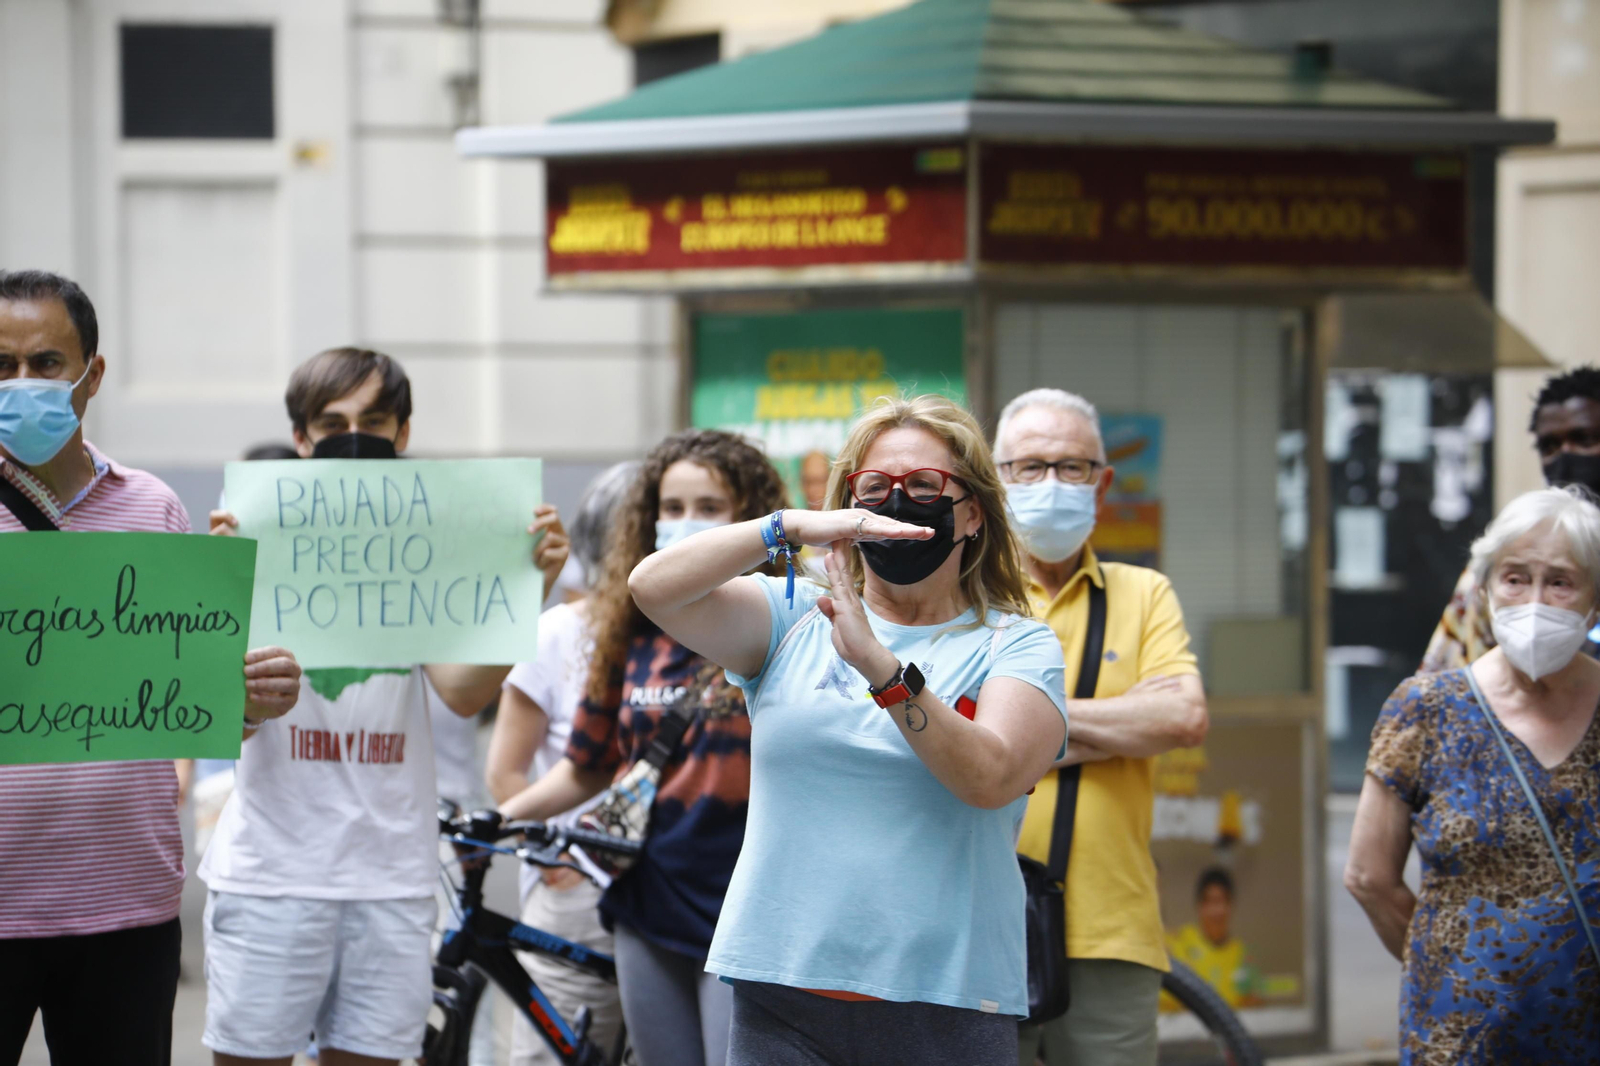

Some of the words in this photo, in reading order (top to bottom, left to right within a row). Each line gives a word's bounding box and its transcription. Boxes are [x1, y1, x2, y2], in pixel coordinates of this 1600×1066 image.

[276, 472, 432, 529] BAJADA
[292, 533, 433, 574] PRECIO
[112, 564, 240, 659] limpias
[0, 678, 213, 751] asequibles
